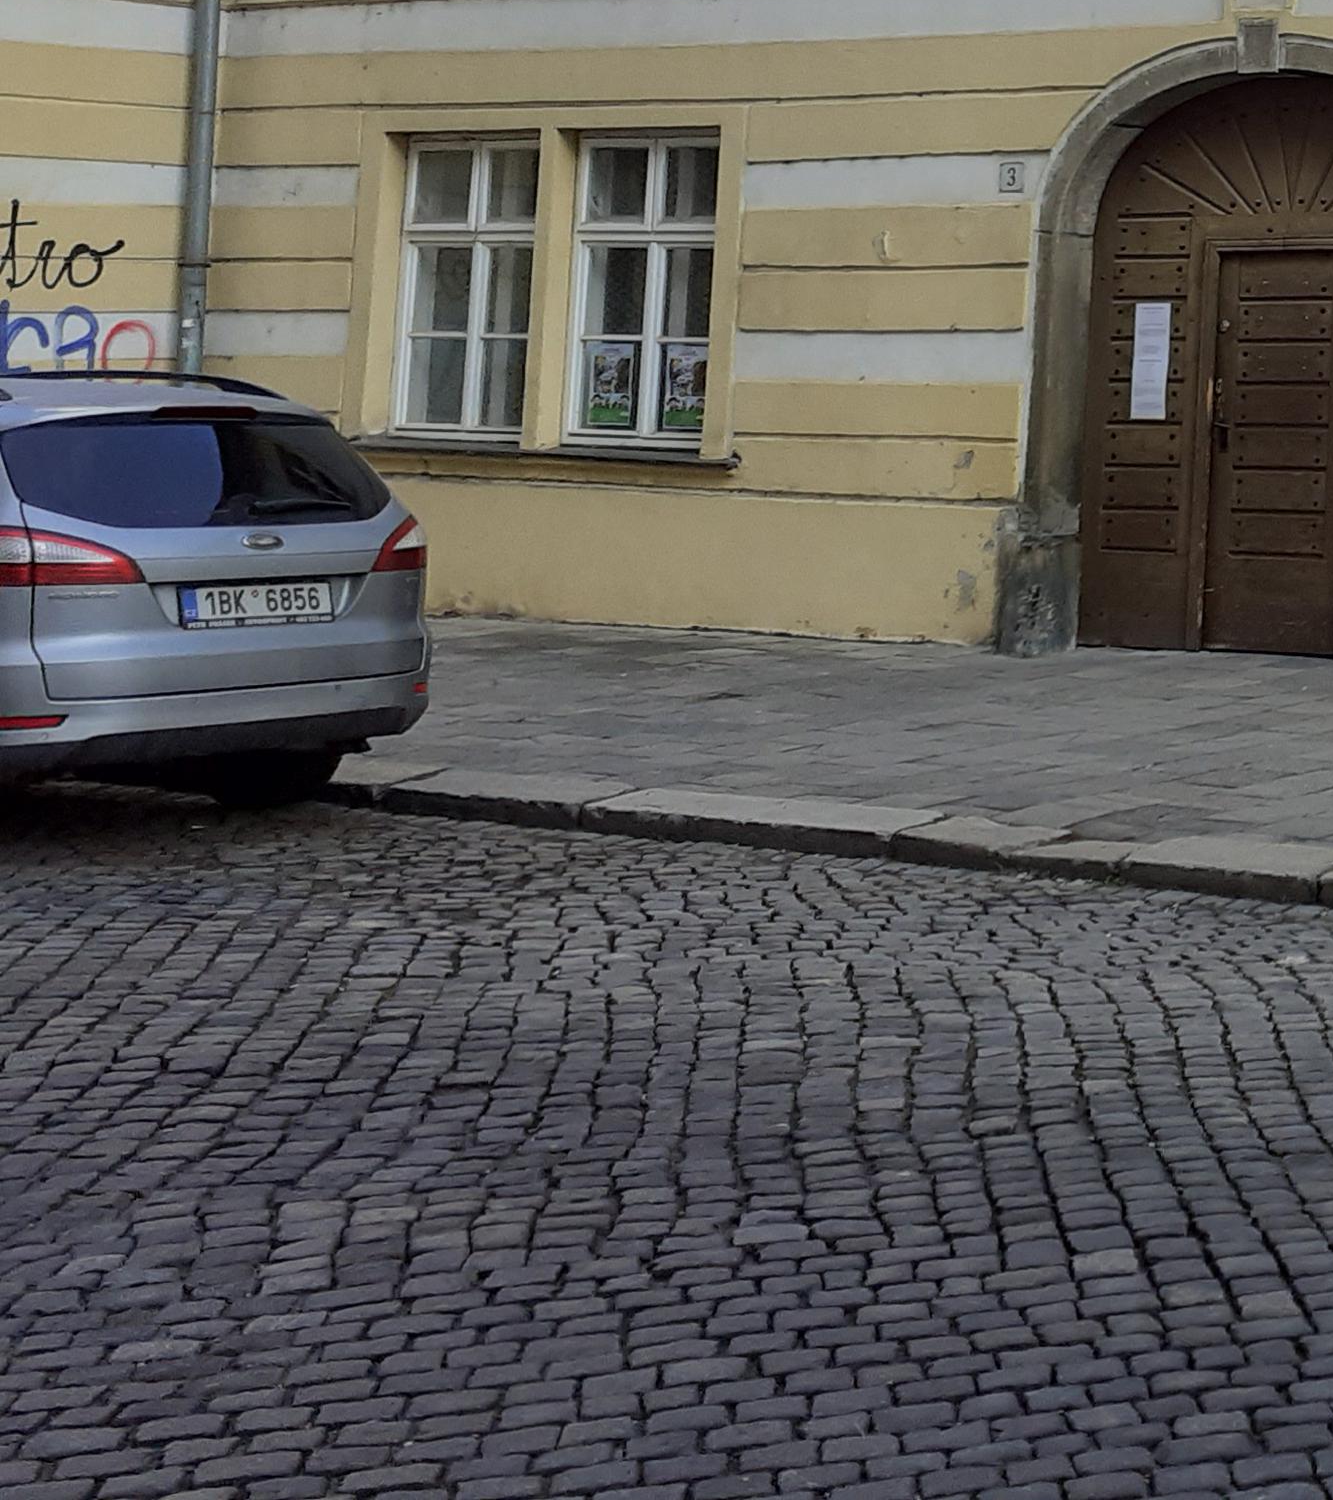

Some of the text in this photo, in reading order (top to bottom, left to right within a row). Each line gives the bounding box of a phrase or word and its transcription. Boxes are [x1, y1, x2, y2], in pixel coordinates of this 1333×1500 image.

[1006, 167, 1017, 187] 3
[205, 586, 321, 616] 1BK 6856
